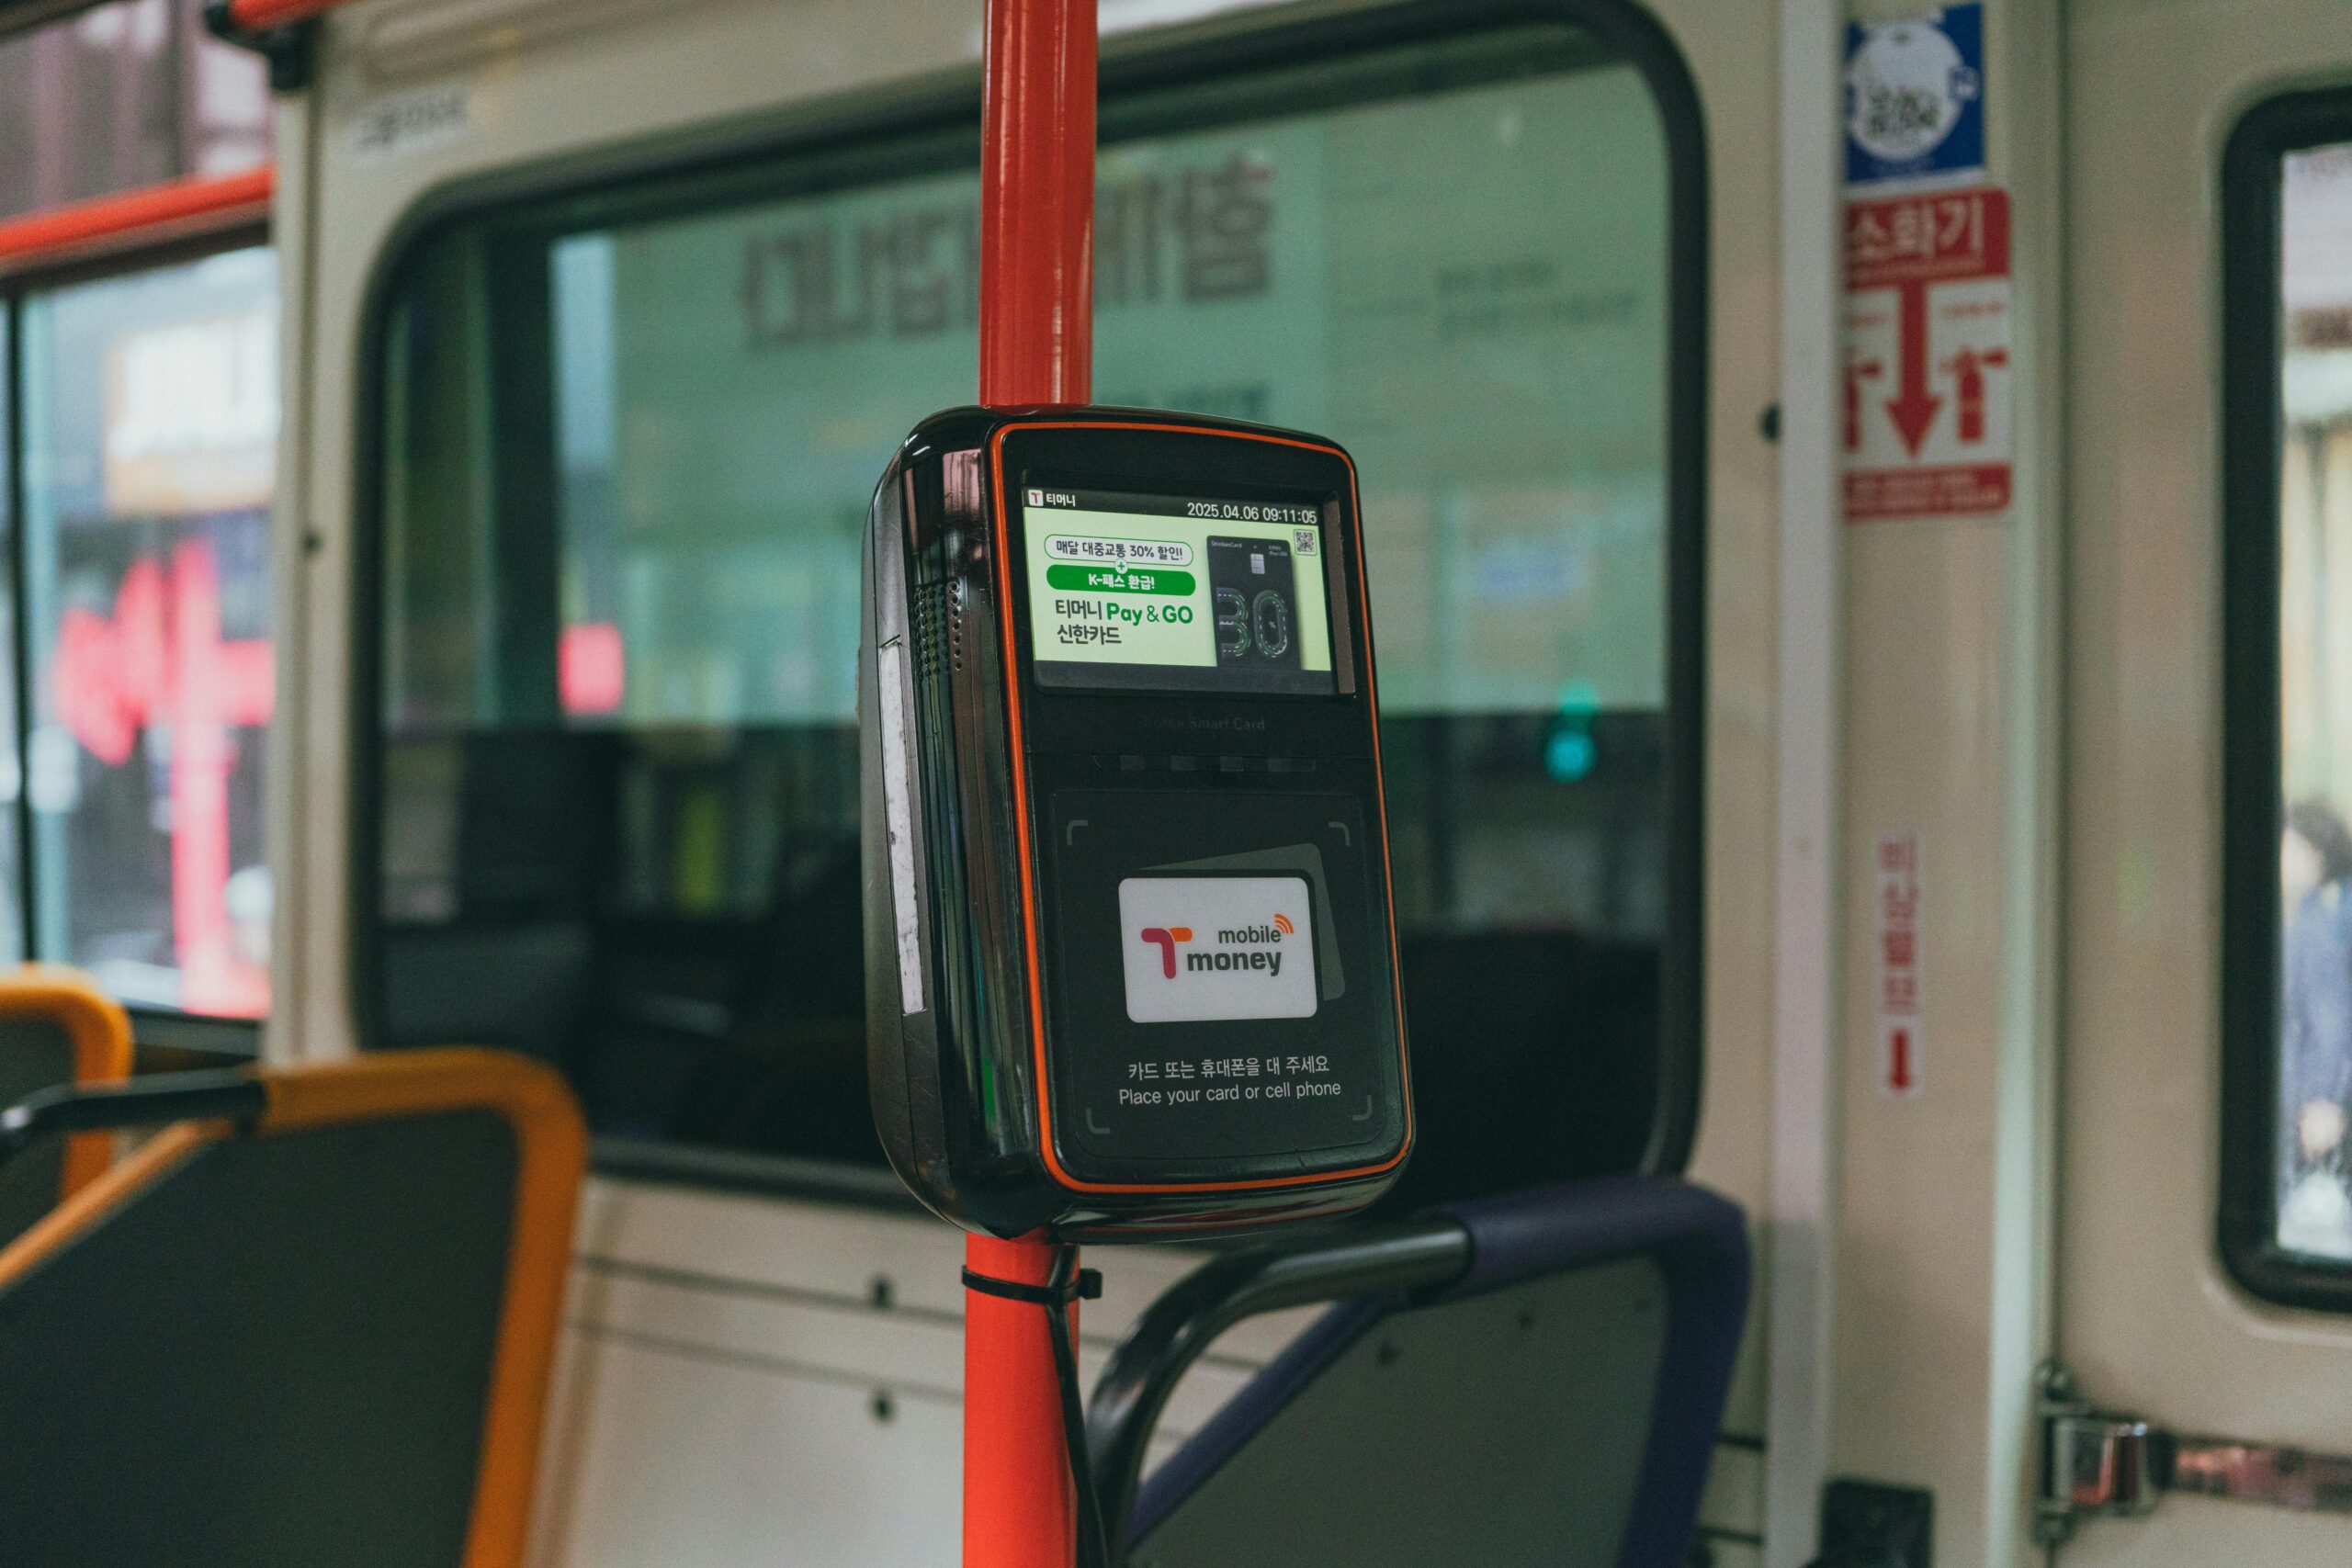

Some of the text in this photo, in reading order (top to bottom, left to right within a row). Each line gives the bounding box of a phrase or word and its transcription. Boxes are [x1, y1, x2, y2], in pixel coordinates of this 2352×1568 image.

[1046, 493, 1076, 507] 티머니
[1187, 502, 1317, 524] 2025.04.06 09:11:05
[1056, 540, 1183, 560] 매달 대중교통 30% 할인!
[1088, 573, 1156, 591] K-패스 환급!
[1056, 599, 1193, 626] 티머니 Pay & GO
[1057, 624, 1122, 645] 신한카드
[1218, 925, 1282, 943] mobile
[1187, 951, 1282, 976] money
[1128, 1055, 1330, 1081] 카드 또는 휴대폰을 대 주세요
[1119, 1081, 1341, 1106] Place your card or cell phone
